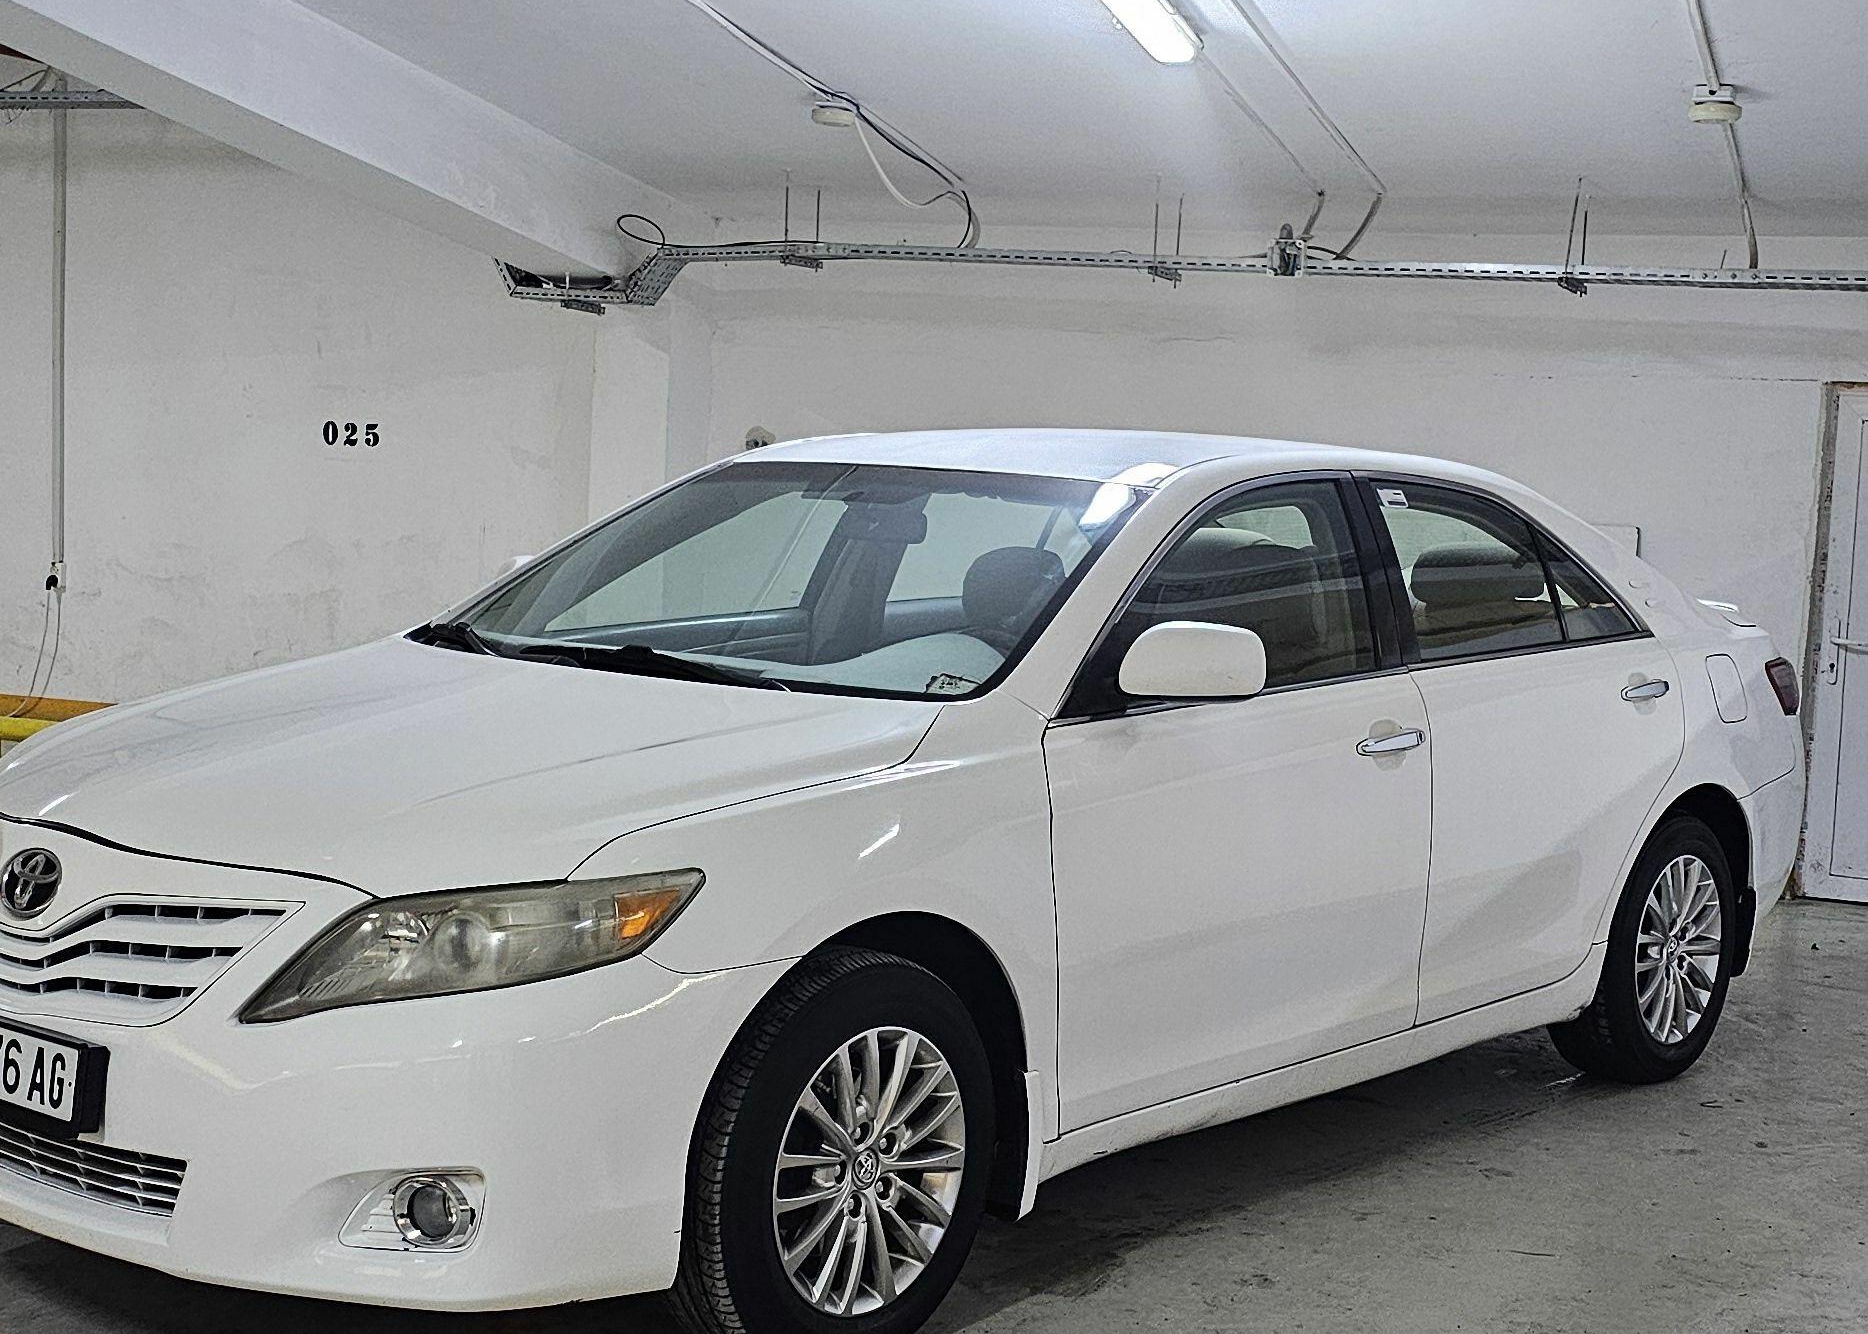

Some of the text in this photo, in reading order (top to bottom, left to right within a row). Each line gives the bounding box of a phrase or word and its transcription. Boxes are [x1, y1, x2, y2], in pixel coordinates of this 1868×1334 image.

[323, 421, 379, 447] 025
[0, 1034, 66, 1109] 6 AG
